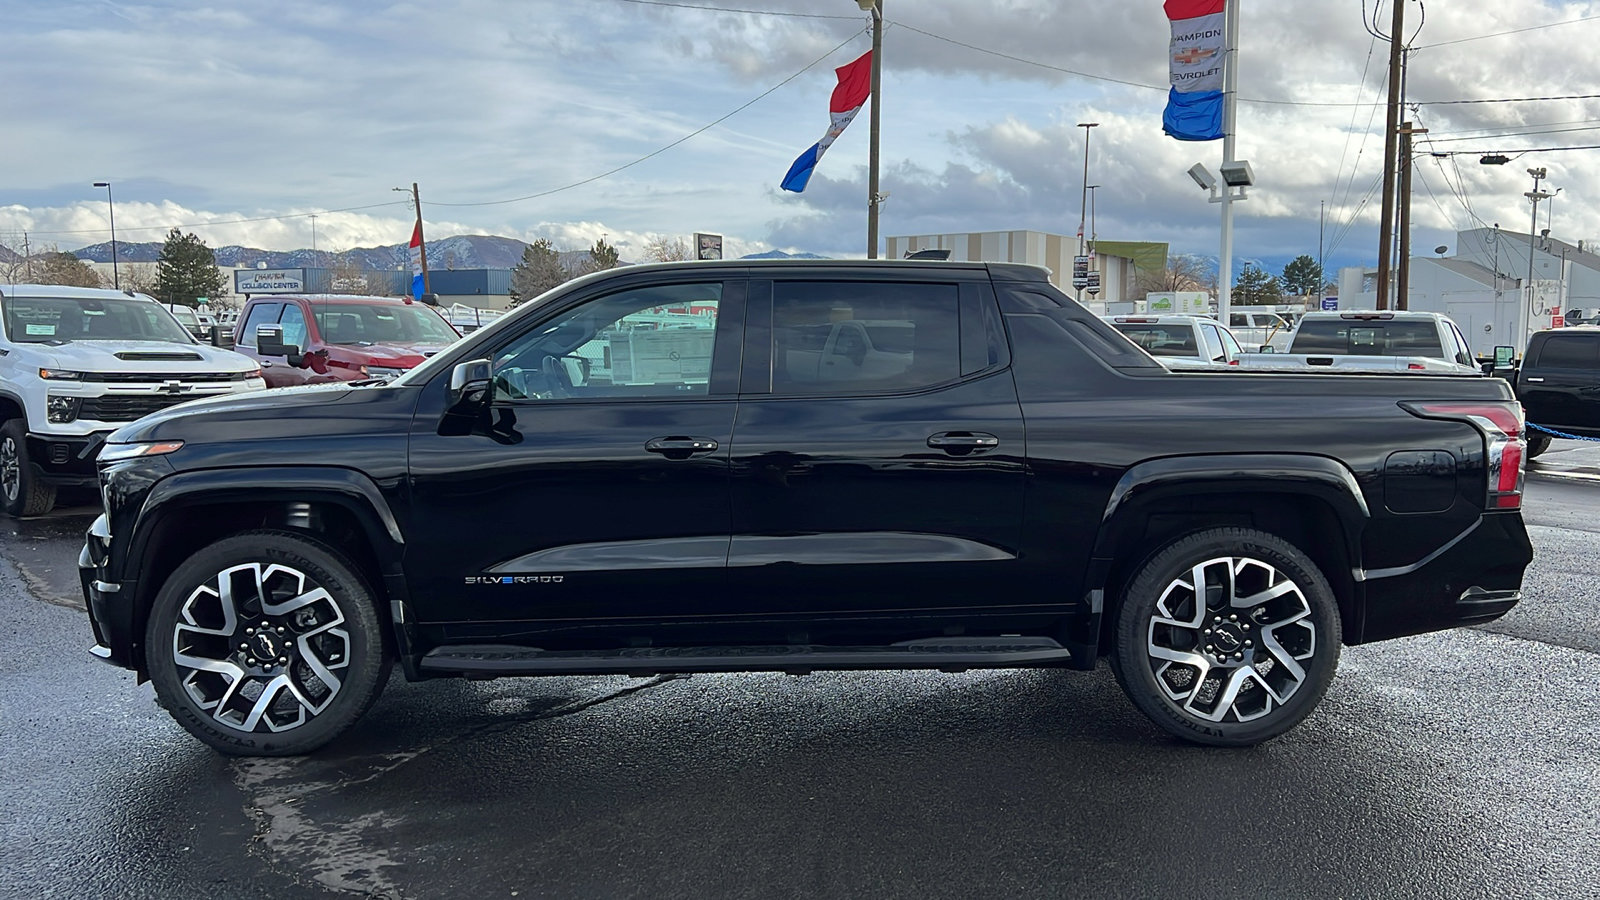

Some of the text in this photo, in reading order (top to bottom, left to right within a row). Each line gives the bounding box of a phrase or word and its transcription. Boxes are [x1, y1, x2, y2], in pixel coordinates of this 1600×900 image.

[1174, 29, 1221, 42] AMPION
[1174, 67, 1221, 81] EVROLET
[465, 575, 564, 584] SILVERADO
